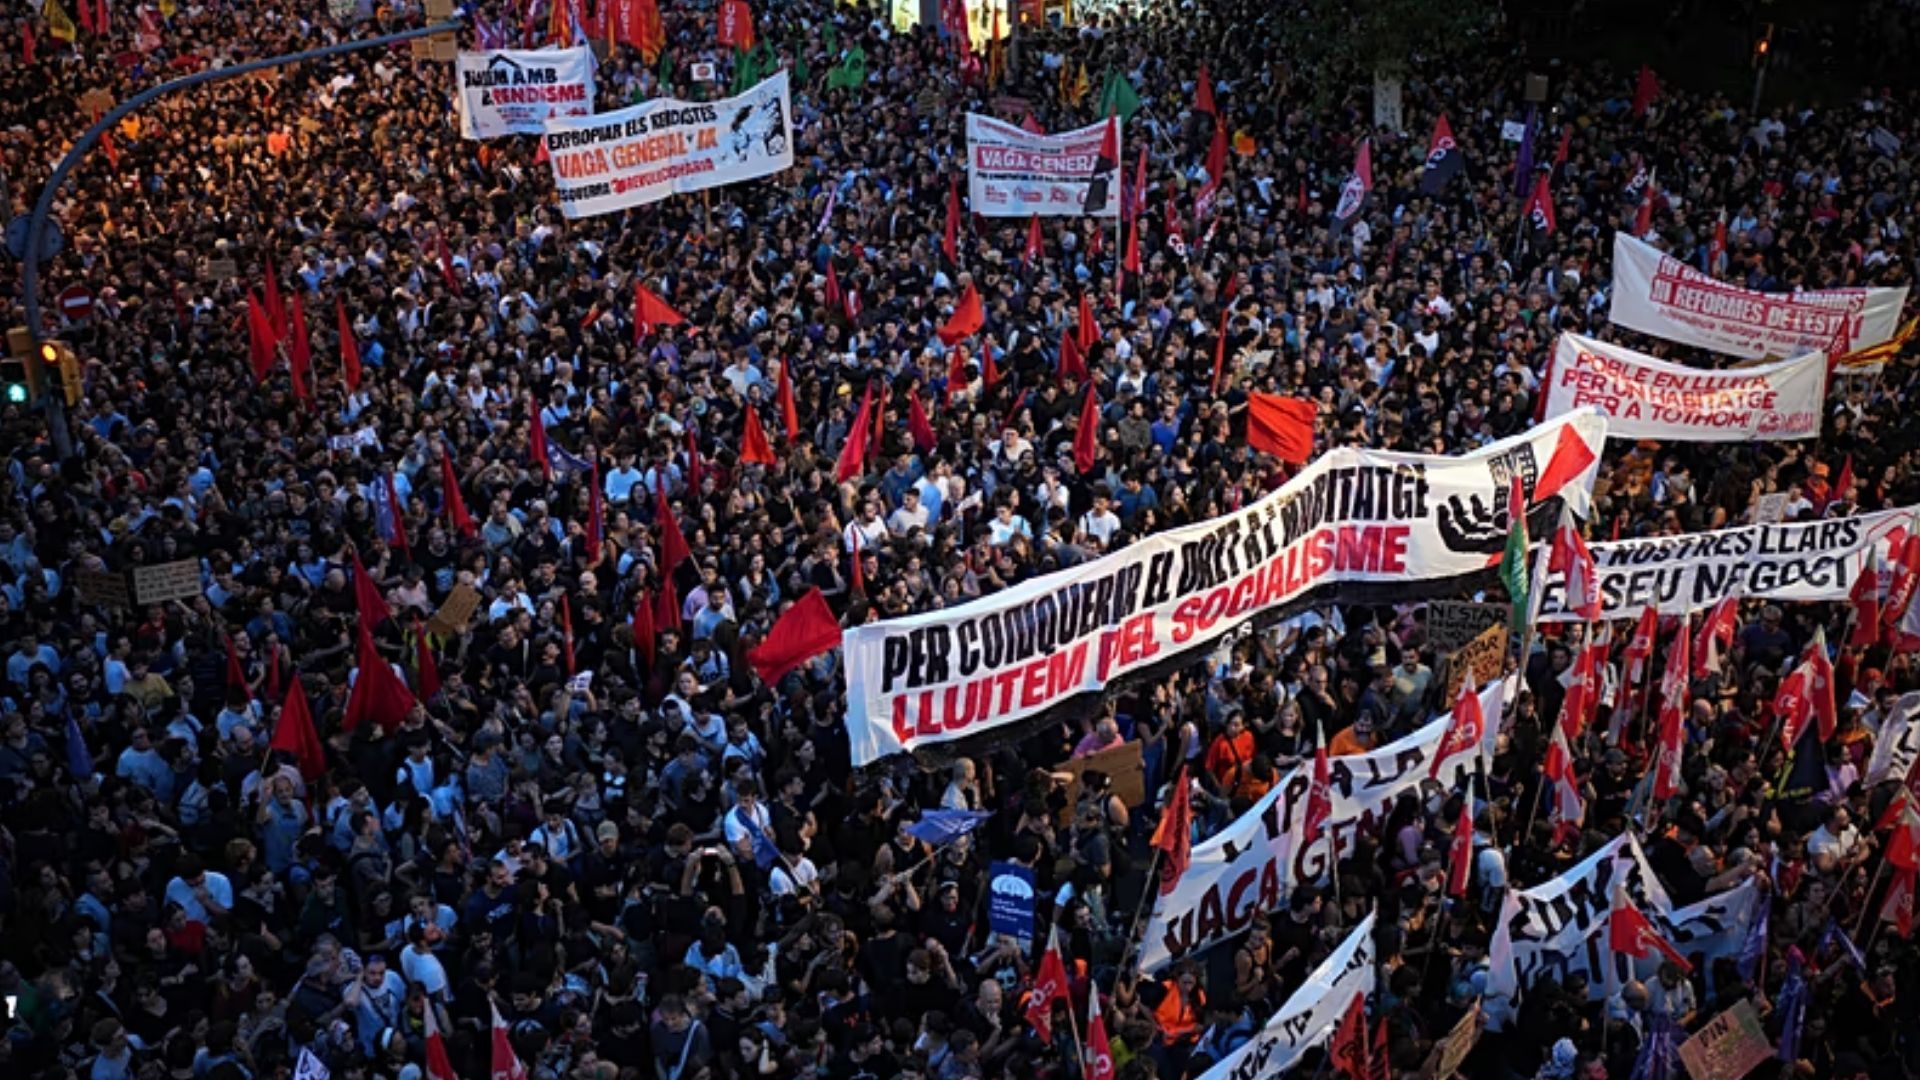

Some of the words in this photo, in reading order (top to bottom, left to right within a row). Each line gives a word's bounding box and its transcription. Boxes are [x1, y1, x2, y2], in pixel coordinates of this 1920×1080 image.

[625, 117, 648, 137] ELS
[556, 149, 609, 179] VAGA
[611, 131, 688, 170] GENERAL
[982, 151, 1026, 167] VAGA
[1030, 155, 1099, 172] GENERA
[1674, 284, 1764, 325] REFORMES
[1768, 305, 1791, 329] DE
[1561, 368, 1608, 390] PER
[1615, 378, 1646, 400] UN
[1649, 384, 1779, 411] HABITATGE
[1576, 351, 1652, 383] POBLE
[1653, 373, 1687, 390] EN
[1573, 389, 1618, 416] PER
[1623, 401, 1641, 420] A
[1608, 529, 1755, 567] NOSTRES
[1757, 517, 1862, 554] LLARS
[882, 624, 950, 693] PER
[956, 560, 1144, 676] CONQUERIR
[1143, 548, 1175, 608] EL
[1176, 517, 1241, 598] DRET
[1601, 566, 1684, 611] SEU
[1692, 555, 1847, 603] NEGOCI
[892, 642, 1089, 743] LLUITEM
[1096, 612, 1161, 682] PEL
[1171, 525, 1411, 644] SOCIALISME
[1163, 857, 1280, 957] VAGA
